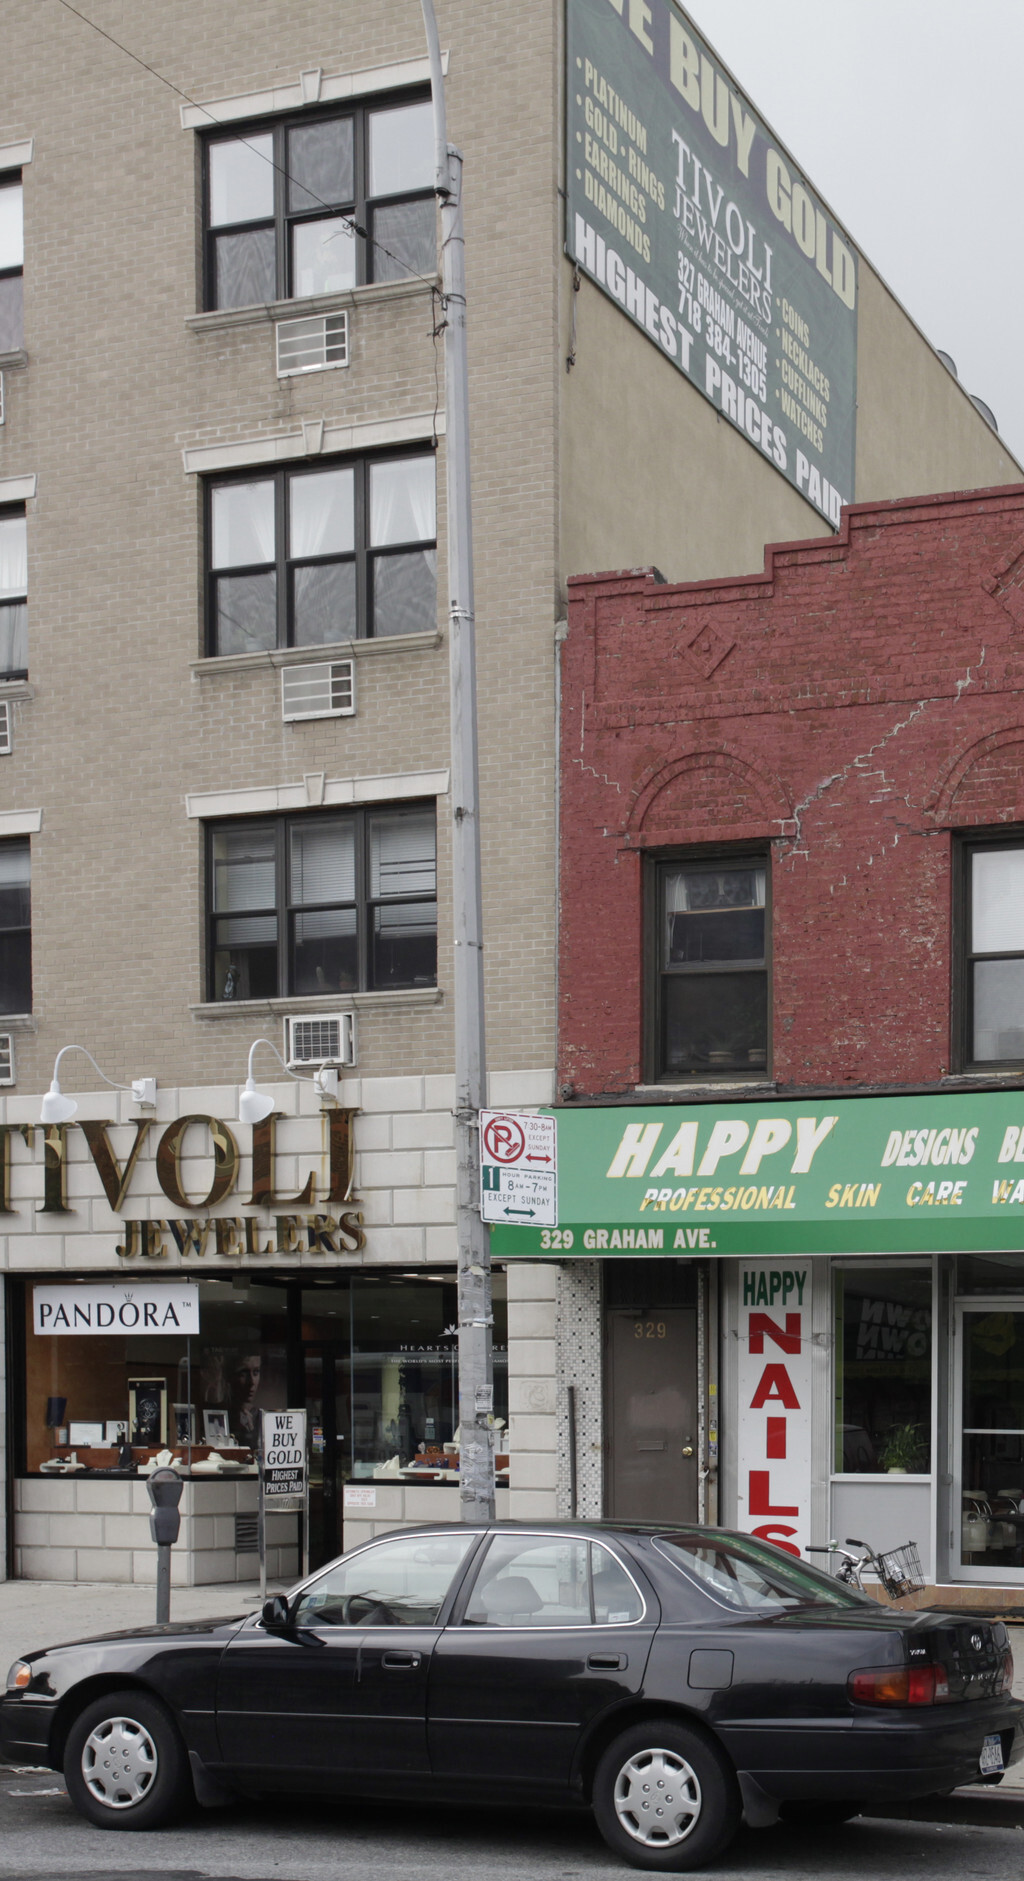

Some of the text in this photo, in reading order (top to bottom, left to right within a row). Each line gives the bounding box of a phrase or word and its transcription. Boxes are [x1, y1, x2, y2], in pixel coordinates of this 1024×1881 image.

[584, 57, 647, 155] PLATINUM
[584, 96, 665, 211] GOLD RINGS
[584, 131, 646, 224] EARRINGS
[608, 0, 855, 310] E BUY GOLD
[584, 168, 651, 264] DIAMONDS
[672, 128, 773, 295] TIVOLI
[673, 185, 771, 324] JEWELERS
[575, 212, 694, 373] HIGHEST
[705, 353, 787, 470] PRICES
[678, 250, 768, 376] 327 GRAHAM AVENUE
[782, 297, 810, 349] COINS
[678, 282, 767, 403] 718 384-1305
[781, 327, 830, 402] NECKLACES
[781, 358, 827, 429] CUFFLINKS
[781, 387, 823, 453] WATCHES
[606, 1116, 839, 1178] HAPPY
[880, 1127, 979, 1167] DESIGNS
[488, 1167, 494, 1189] 1
[488, 1193, 550, 1206] EXCEPT SUNDAY
[639, 1186, 796, 1211] PROFESSIONAL
[825, 1183, 882, 1208] SKIN
[906, 1180, 968, 1206] CARE
[115, 1211, 367, 1258] JEWELERS
[540, 1228, 717, 1249] 329 GRAHAM AVE.
[41, 1302, 181, 1327] PANDORA
[743, 1271, 808, 1306] HAPPY
[634, 1322, 667, 1339] 329
[272, 1433, 298, 1447] BUY
[275, 1415, 293, 1430] WE
[267, 1450, 302, 1465] GOLD
[271, 1470, 299, 1481] HIGHEST
[265, 1480, 303, 1494] PRICES PAID
